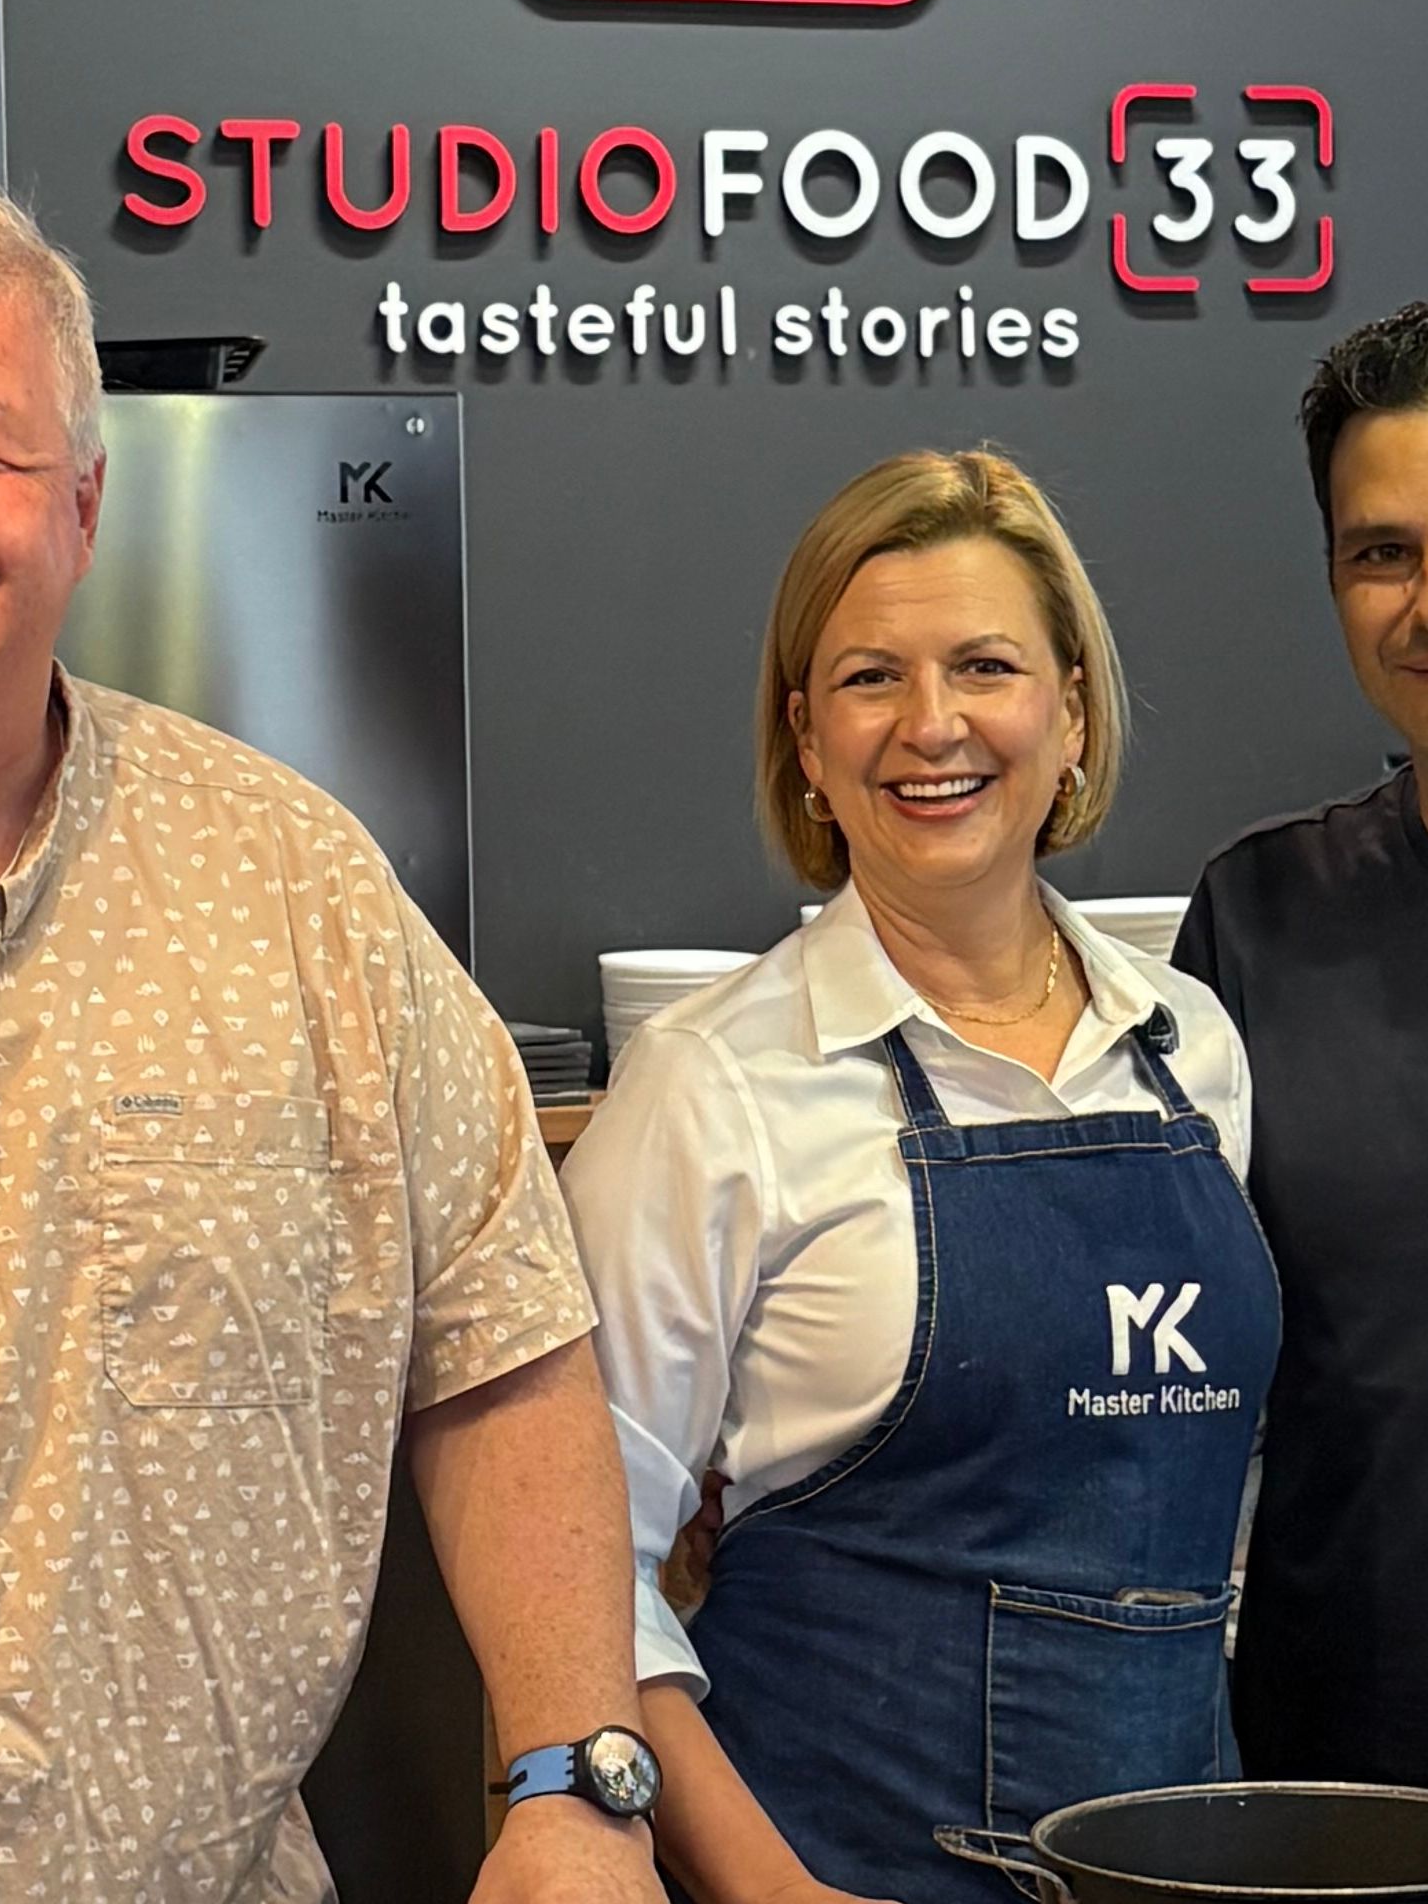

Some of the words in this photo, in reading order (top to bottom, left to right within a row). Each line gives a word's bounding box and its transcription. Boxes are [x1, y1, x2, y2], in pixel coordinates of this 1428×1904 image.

[1153, 138, 1297, 244] 33
[379, 282, 737, 357] tasteful
[774, 286, 1079, 358] stories
[338, 461, 393, 503] MK
[1105, 1282, 1208, 1376] MK
[1068, 1387, 1155, 1416] Master
[1160, 1383, 1240, 1414] Kitchen
